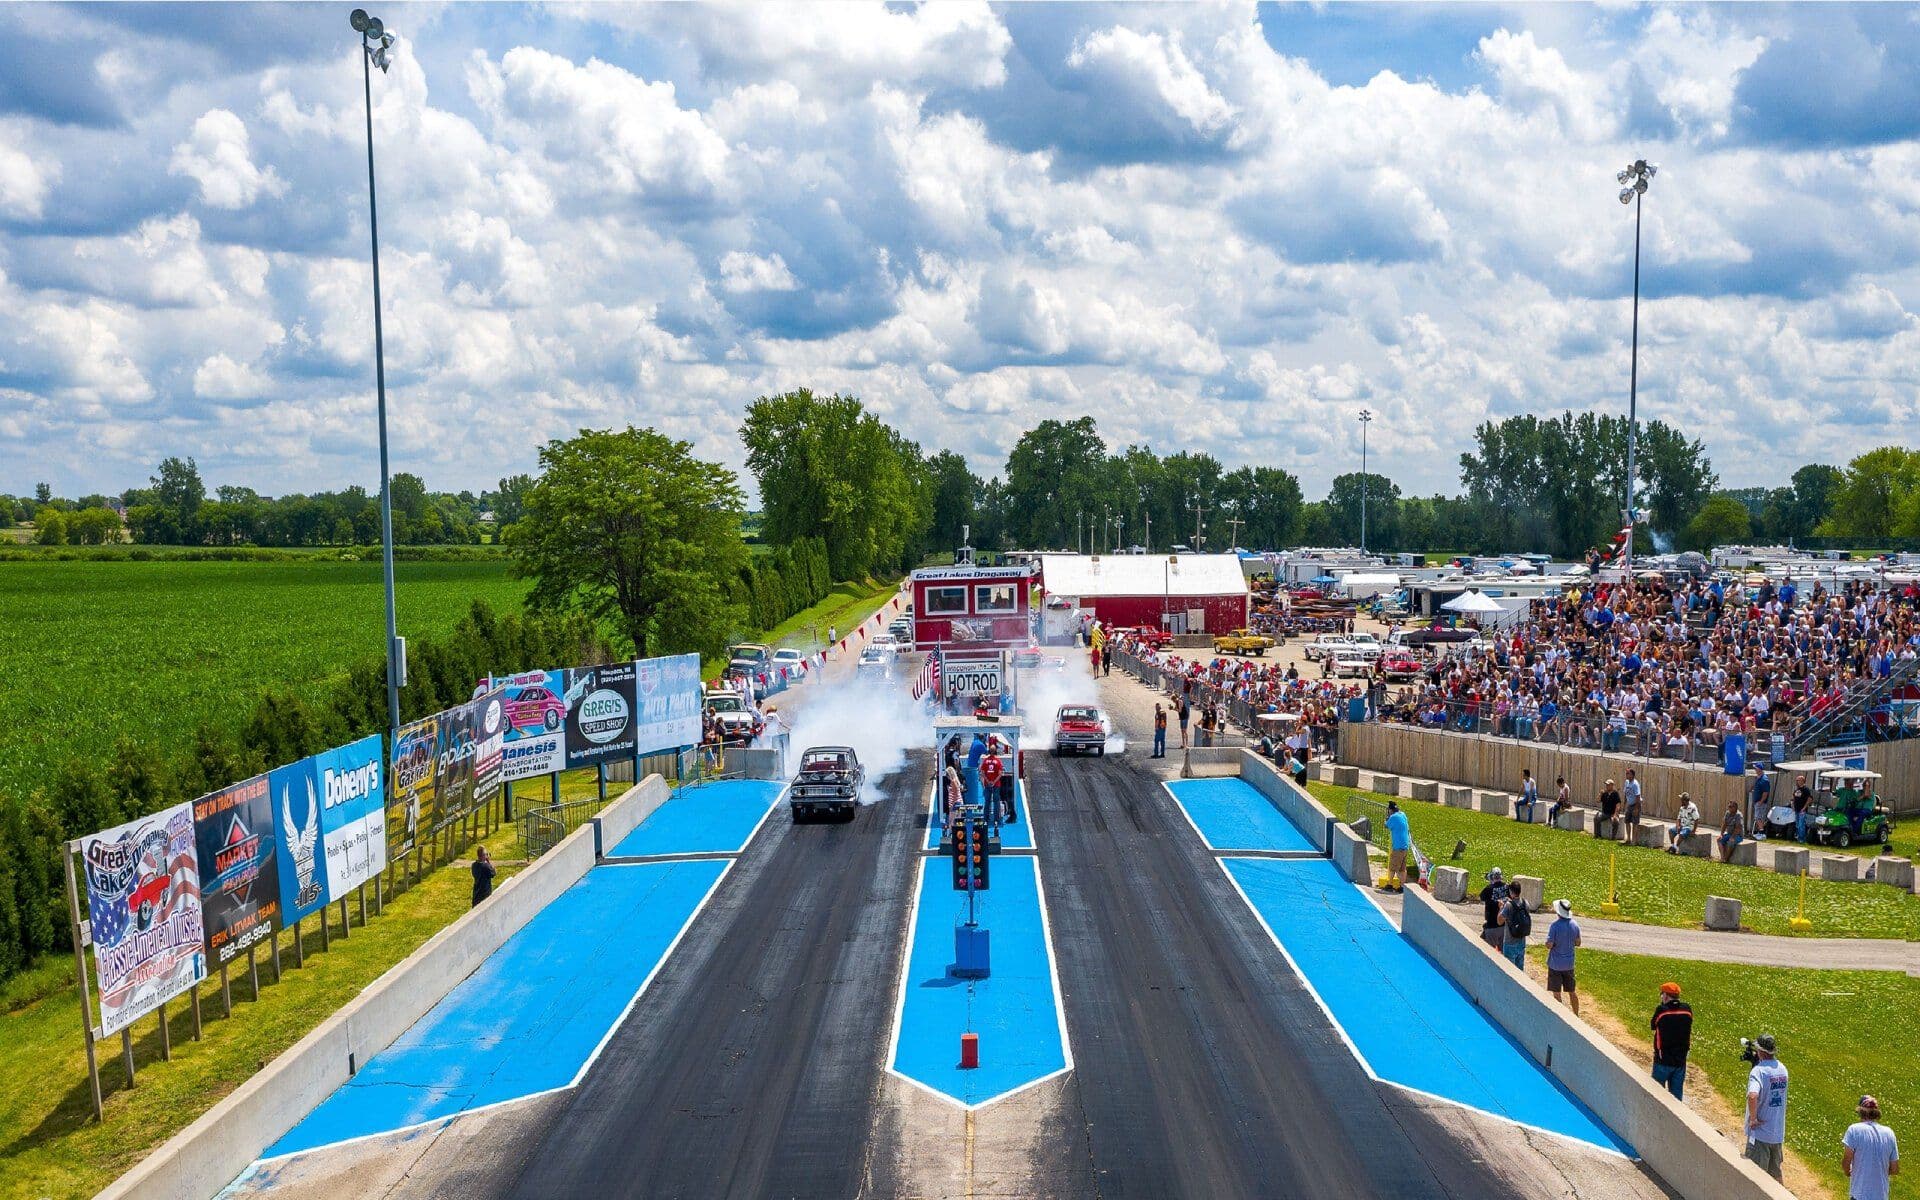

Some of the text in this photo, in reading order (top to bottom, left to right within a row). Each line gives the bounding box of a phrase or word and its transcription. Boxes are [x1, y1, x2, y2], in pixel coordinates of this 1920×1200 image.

[973, 570, 1022, 578] Dragaway
[948, 672, 998, 691] HOTROD
[583, 698, 623, 718] GREG'S
[584, 718, 624, 733] SPEED SHOP
[399, 761, 431, 789] Gaskets
[502, 755, 552, 769] RANSPORTATION
[324, 759, 379, 811] Doheny's
[195, 802, 208, 821] STAY
[208, 799, 217, 815] ON
[217, 794, 234, 812] TRACK
[88, 838, 131, 870] Great
[132, 829, 169, 869] Dragaway
[216, 837, 259, 873] MARKET
[327, 846, 340, 859] Pools
[87, 860, 134, 893] Lakes
[211, 930, 228, 948] ERIK
[257, 901, 276, 920] TEAM
[100, 903, 201, 991] Classic American Muscle
